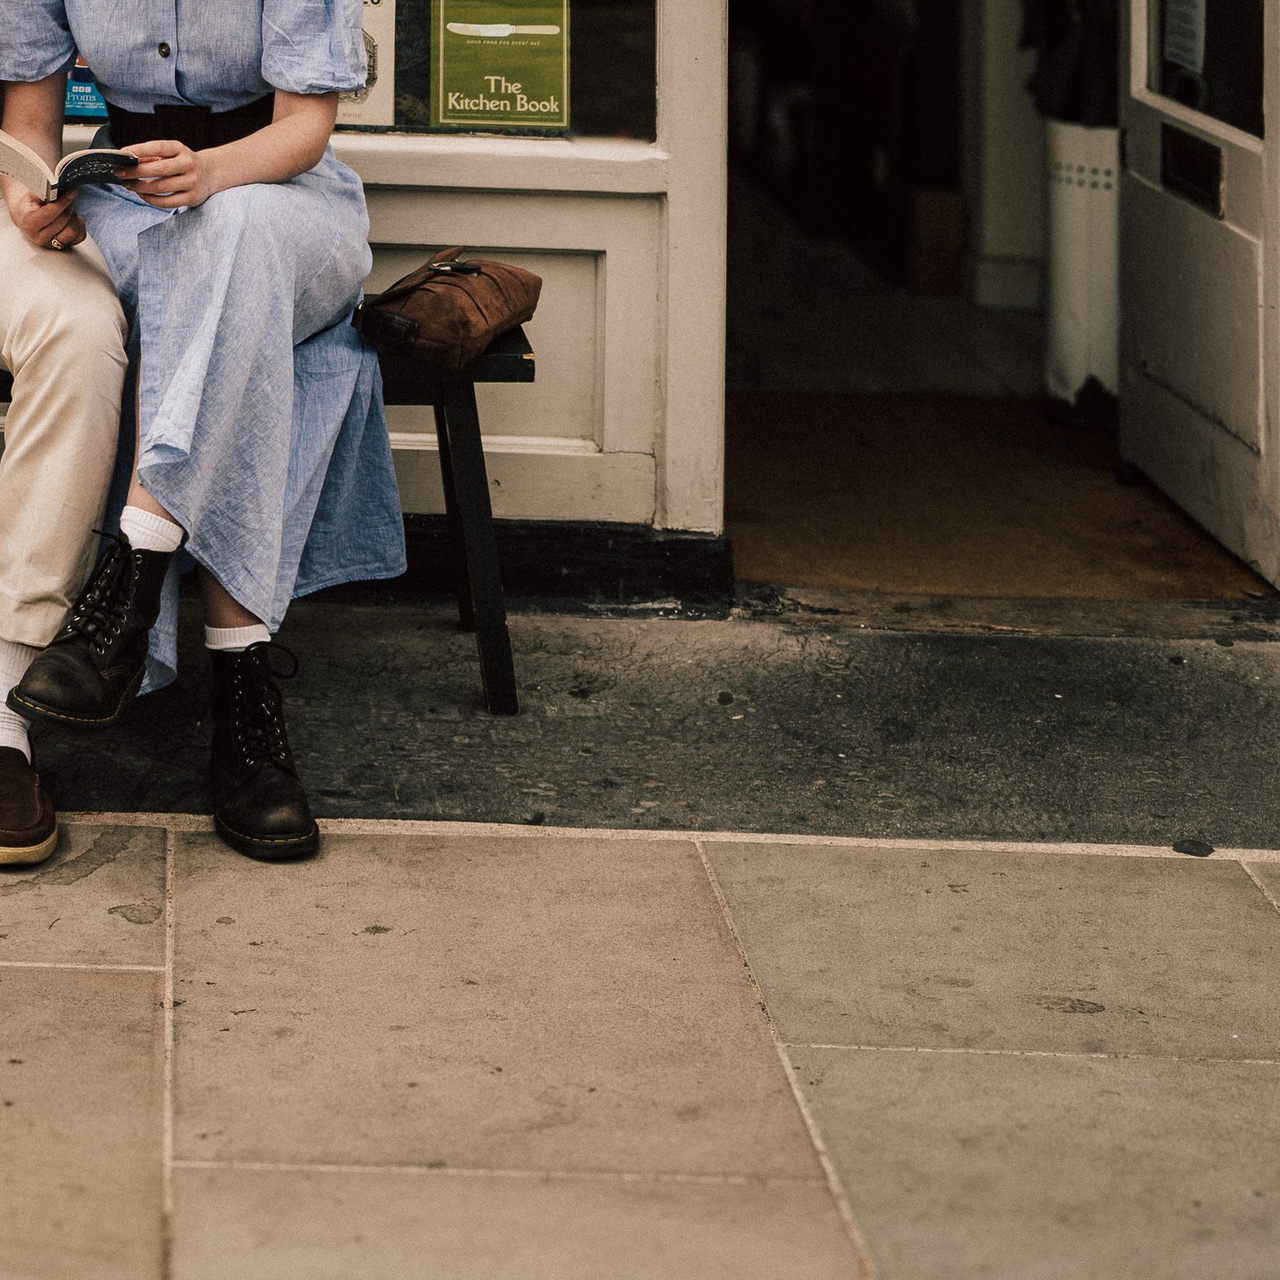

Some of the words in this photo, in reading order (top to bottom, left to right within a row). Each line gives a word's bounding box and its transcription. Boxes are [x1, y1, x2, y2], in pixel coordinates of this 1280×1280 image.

[483, 75, 522, 94] The
[67, 92, 96, 102] Proms
[447, 92, 511, 112] Kitchen
[515, 94, 560, 113] Book
